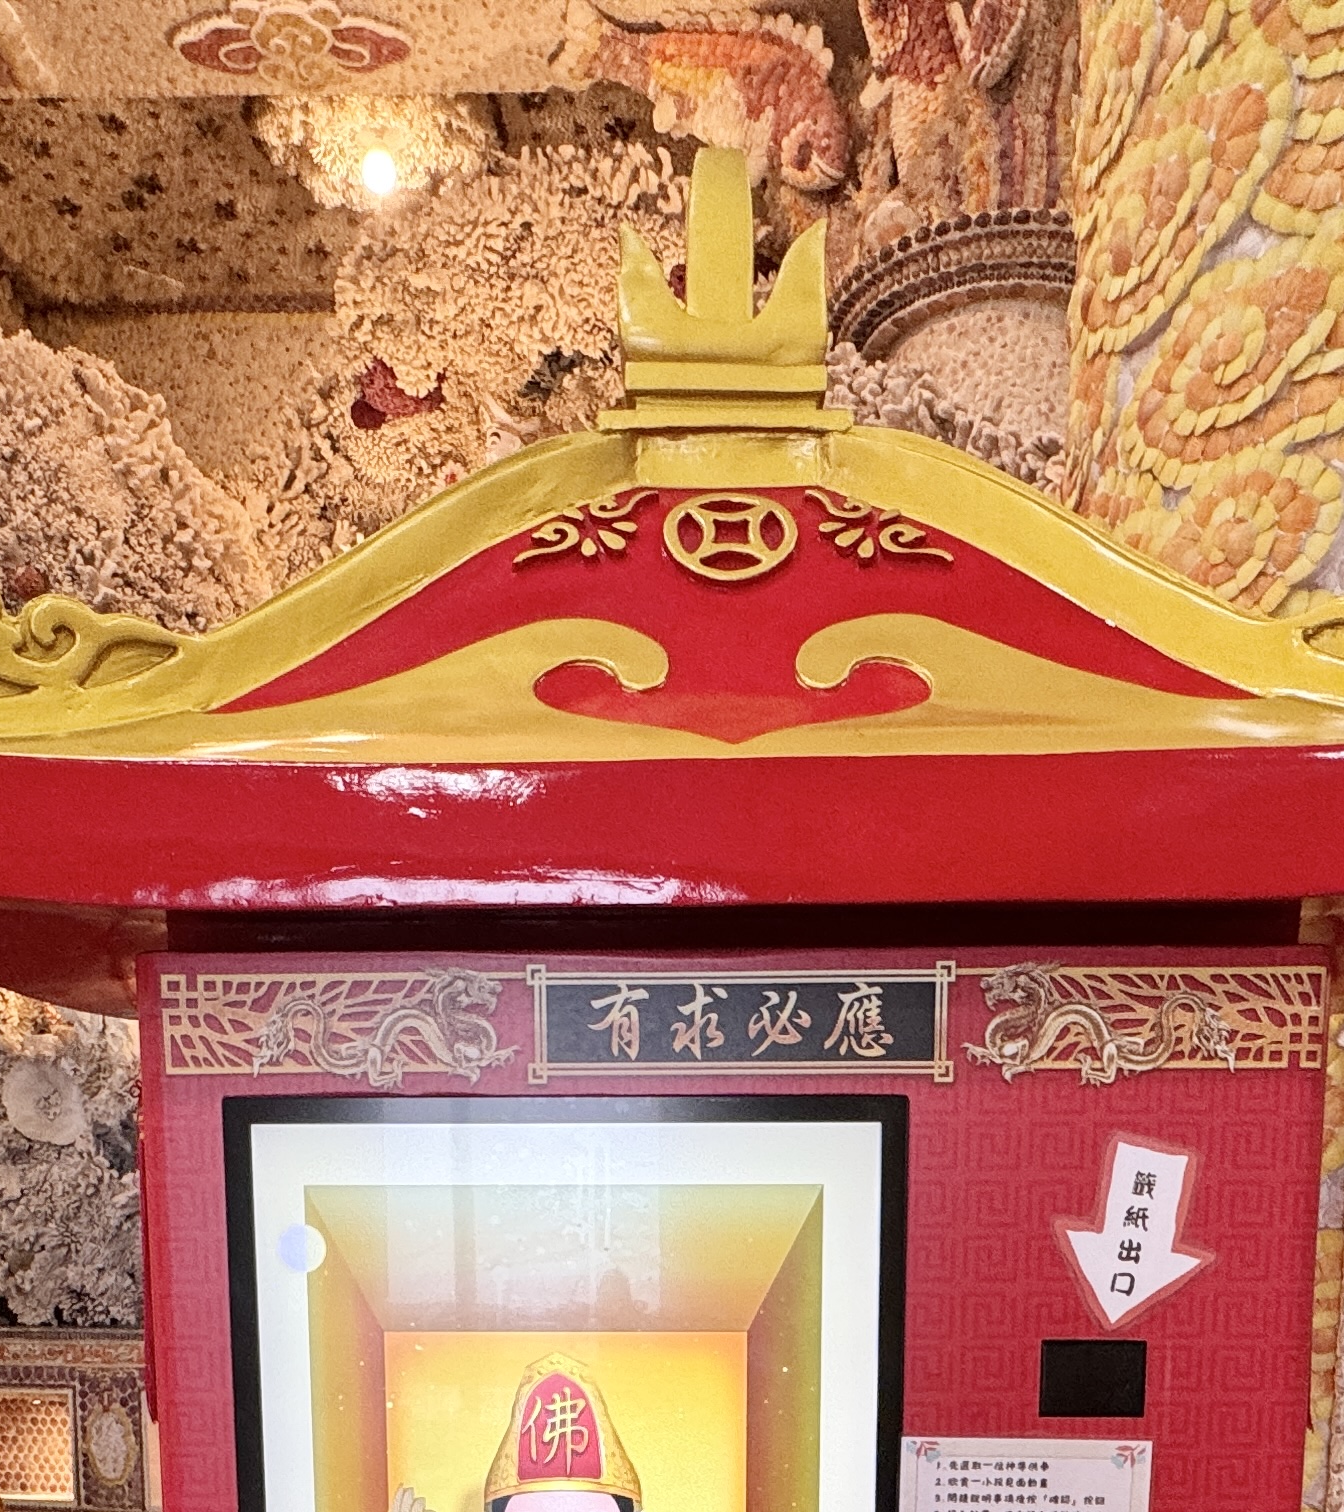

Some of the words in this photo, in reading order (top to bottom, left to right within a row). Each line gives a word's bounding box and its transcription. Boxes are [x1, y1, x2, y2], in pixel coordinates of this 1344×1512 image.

[586, 981, 895, 1061] 有求必應
[522, 1386, 590, 1476] 佛
